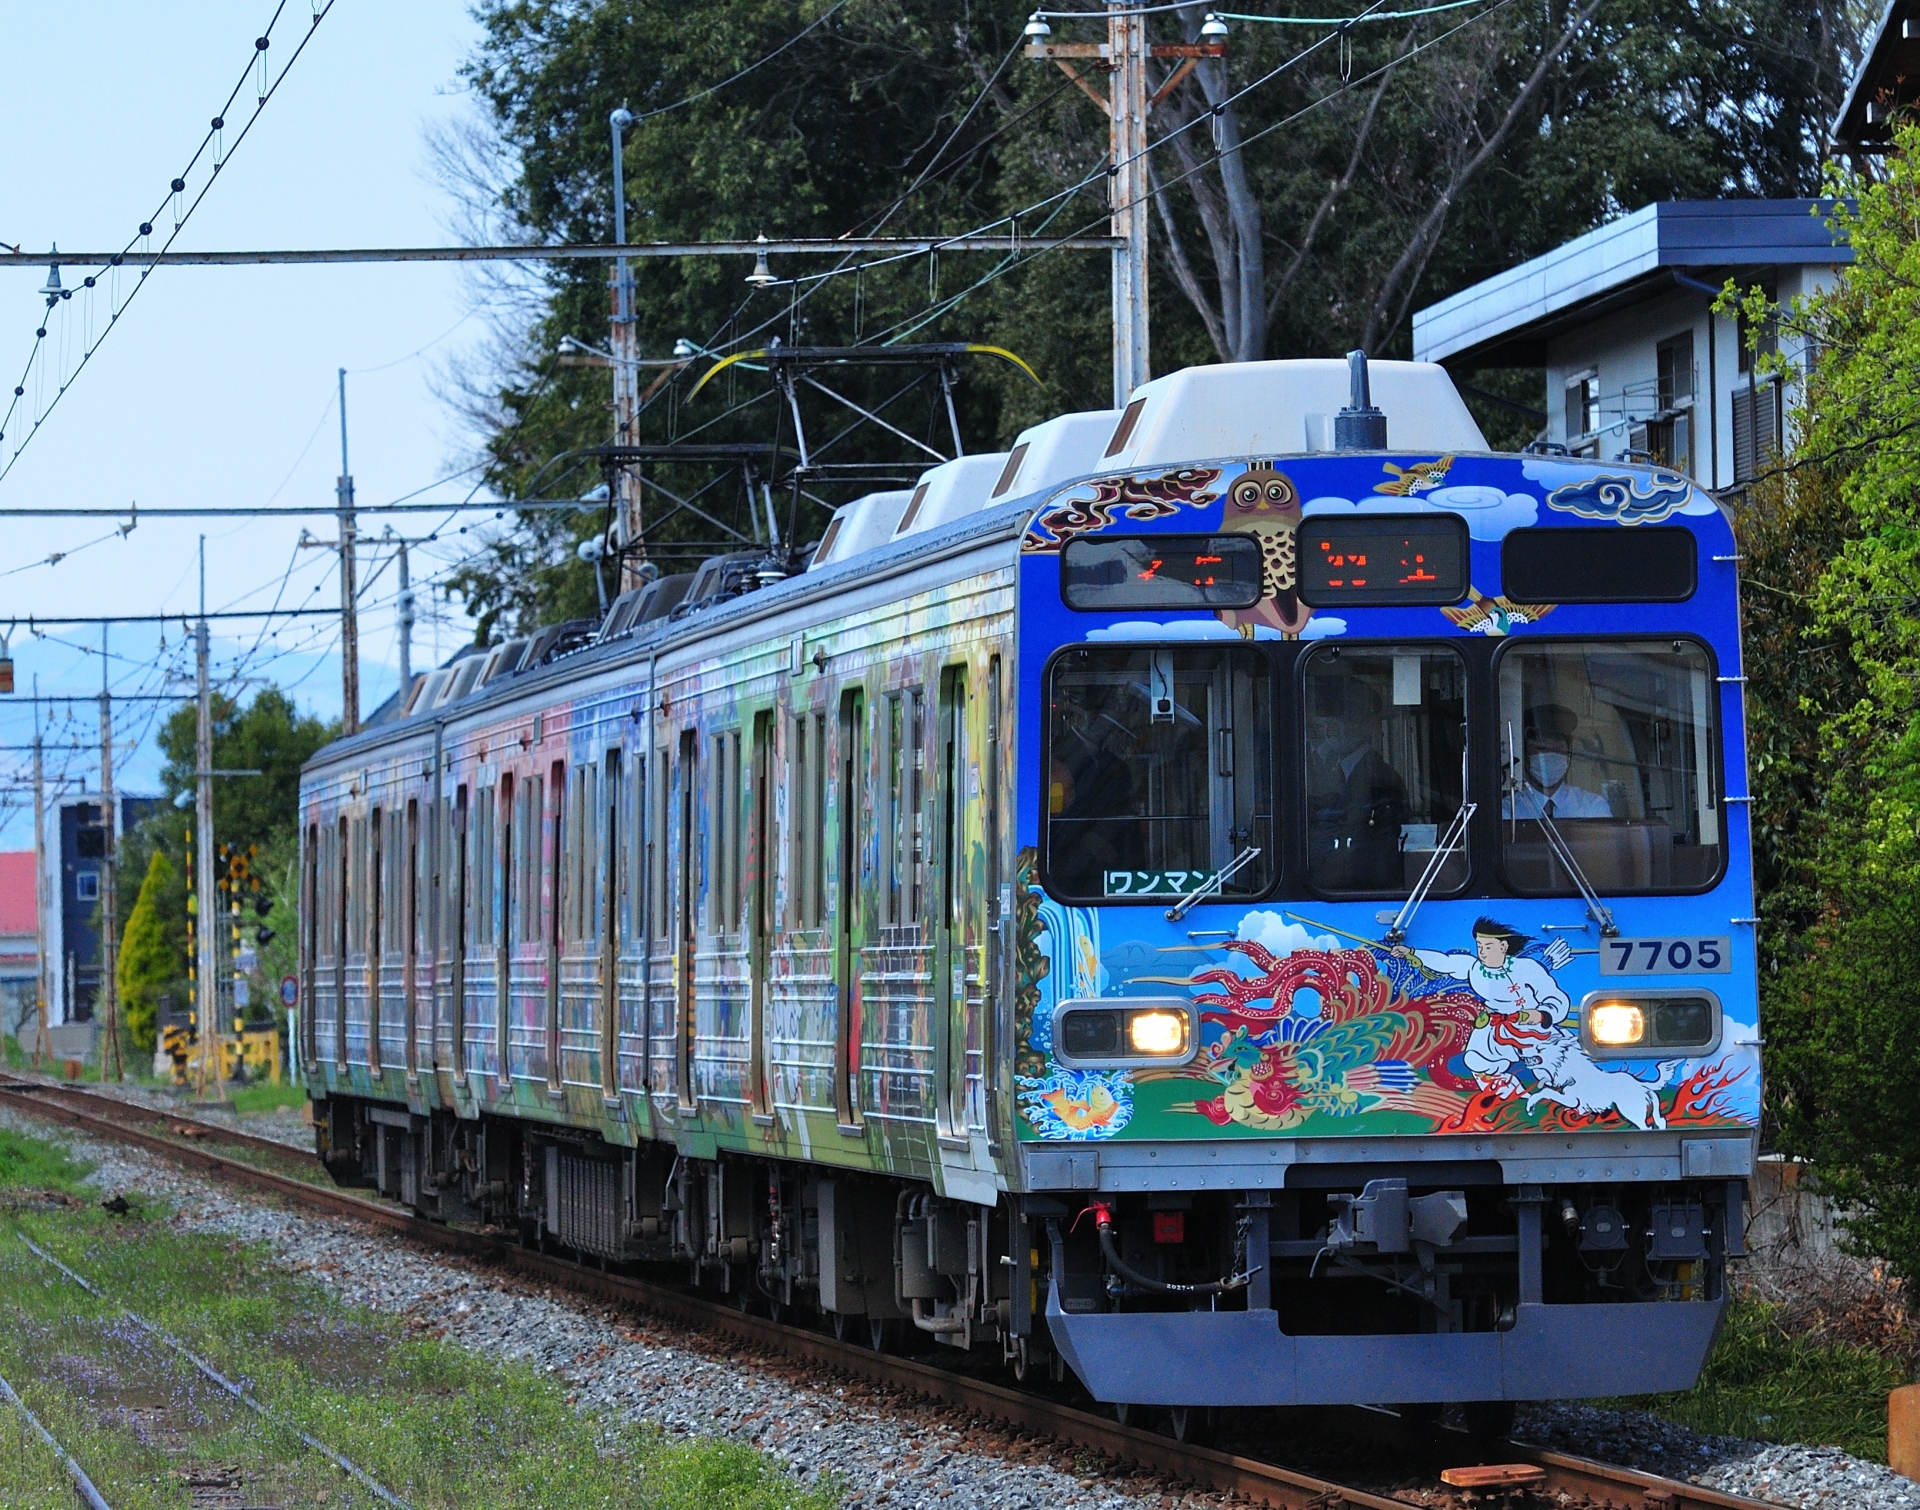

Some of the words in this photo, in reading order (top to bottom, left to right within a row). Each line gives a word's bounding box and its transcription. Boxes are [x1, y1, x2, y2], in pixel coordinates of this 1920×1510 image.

[1109, 870, 1215, 893] ワンマン
[1609, 940, 1721, 971] 7705
